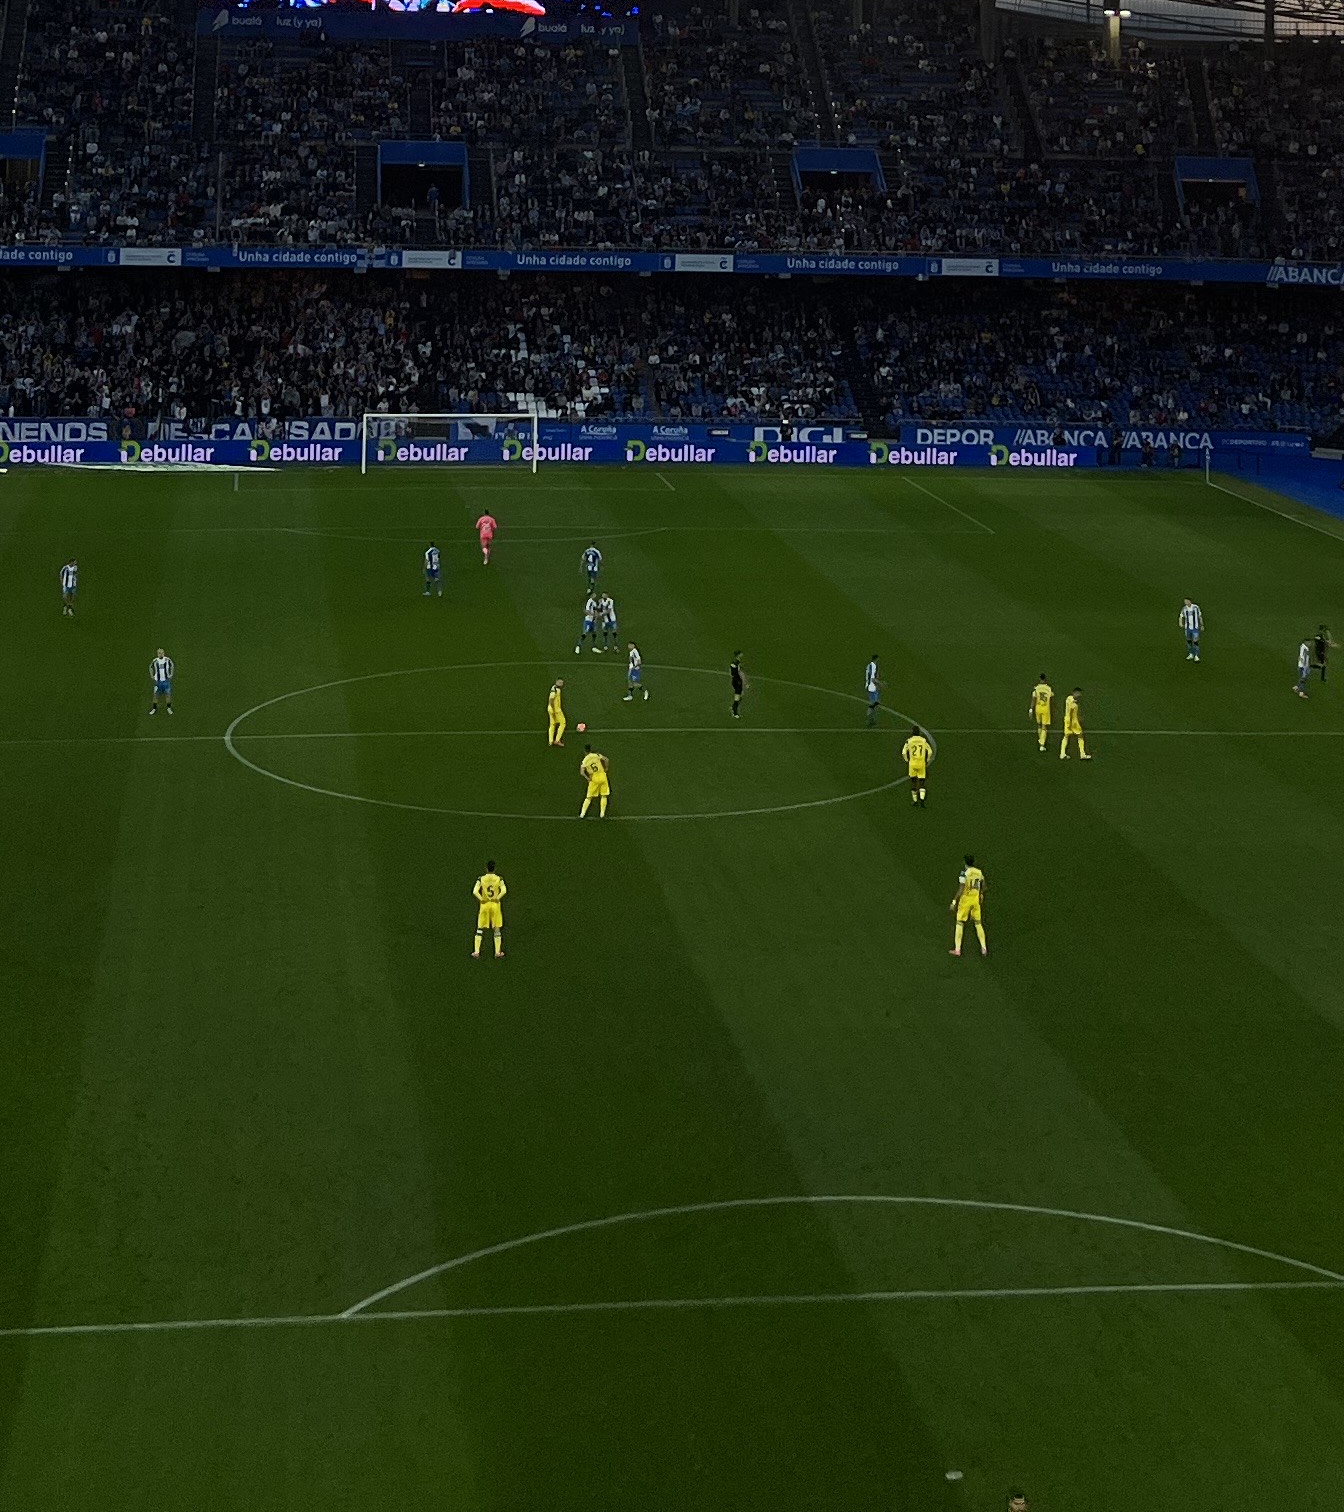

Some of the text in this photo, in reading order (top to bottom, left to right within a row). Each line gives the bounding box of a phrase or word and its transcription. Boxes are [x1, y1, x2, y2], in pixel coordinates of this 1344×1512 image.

[27, 249, 74, 264] contigo
[238, 250, 358, 266] Unha cidade contigo
[516, 254, 632, 269] Unha cidade contigo
[787, 257, 899, 273] Unha cidade contigo
[1052, 262, 1163, 279] Unha cidade contigo
[916, 428, 995, 445] DEPOR
[911, 745, 923, 756] 27
